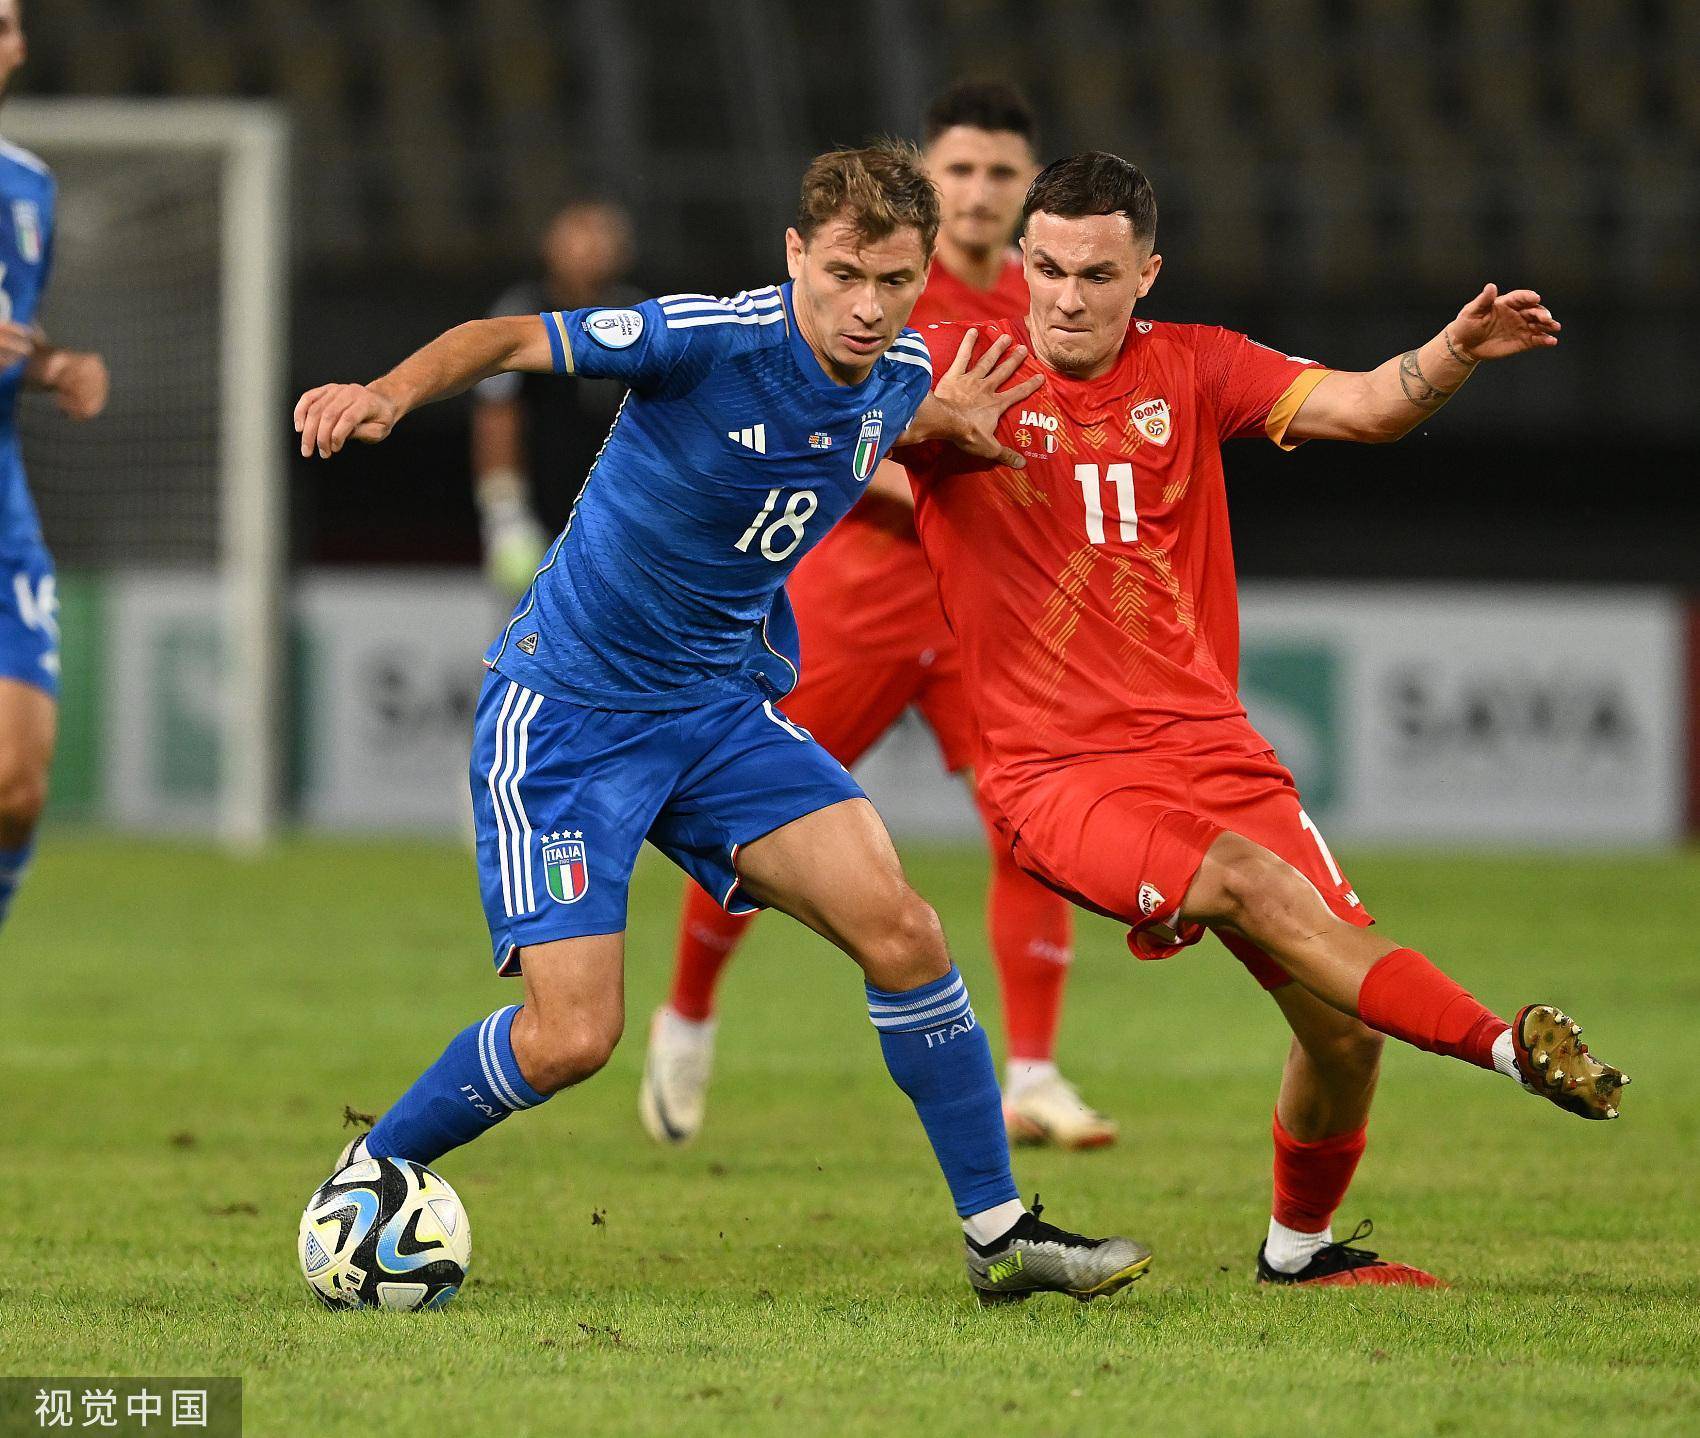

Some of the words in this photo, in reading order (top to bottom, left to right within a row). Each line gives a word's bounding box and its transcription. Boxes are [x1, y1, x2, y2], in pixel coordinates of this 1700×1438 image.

[1019, 410, 1059, 432] JAKO
[734, 486, 818, 562] 18
[1074, 463, 1139, 544] 11
[546, 844, 582, 862] ITALIA
